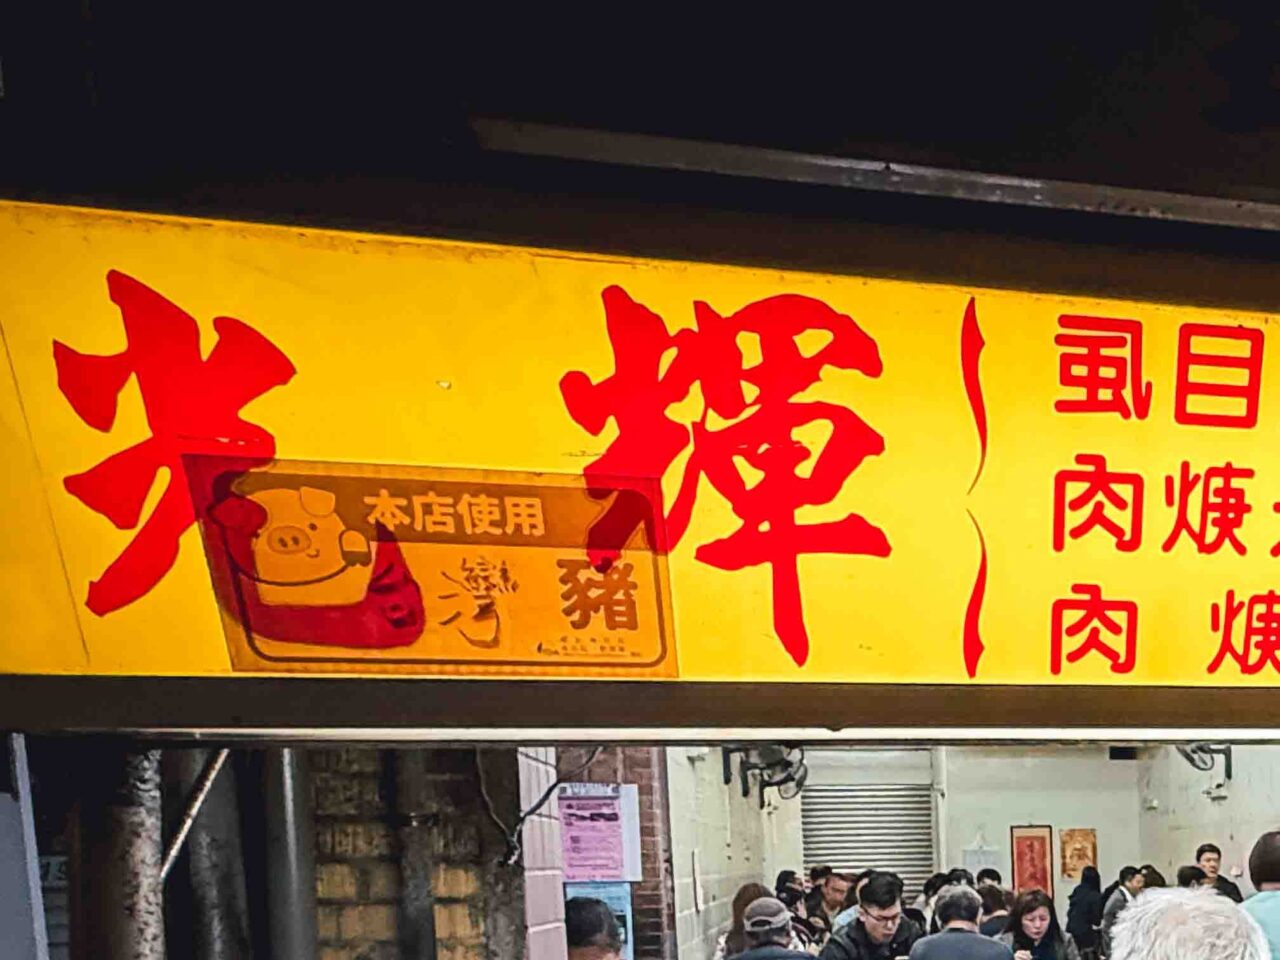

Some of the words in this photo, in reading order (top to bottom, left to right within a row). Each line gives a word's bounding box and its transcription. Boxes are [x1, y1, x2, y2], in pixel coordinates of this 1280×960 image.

[53, 268, 893, 668] 光輝
[363, 488, 546, 537] 本店使用
